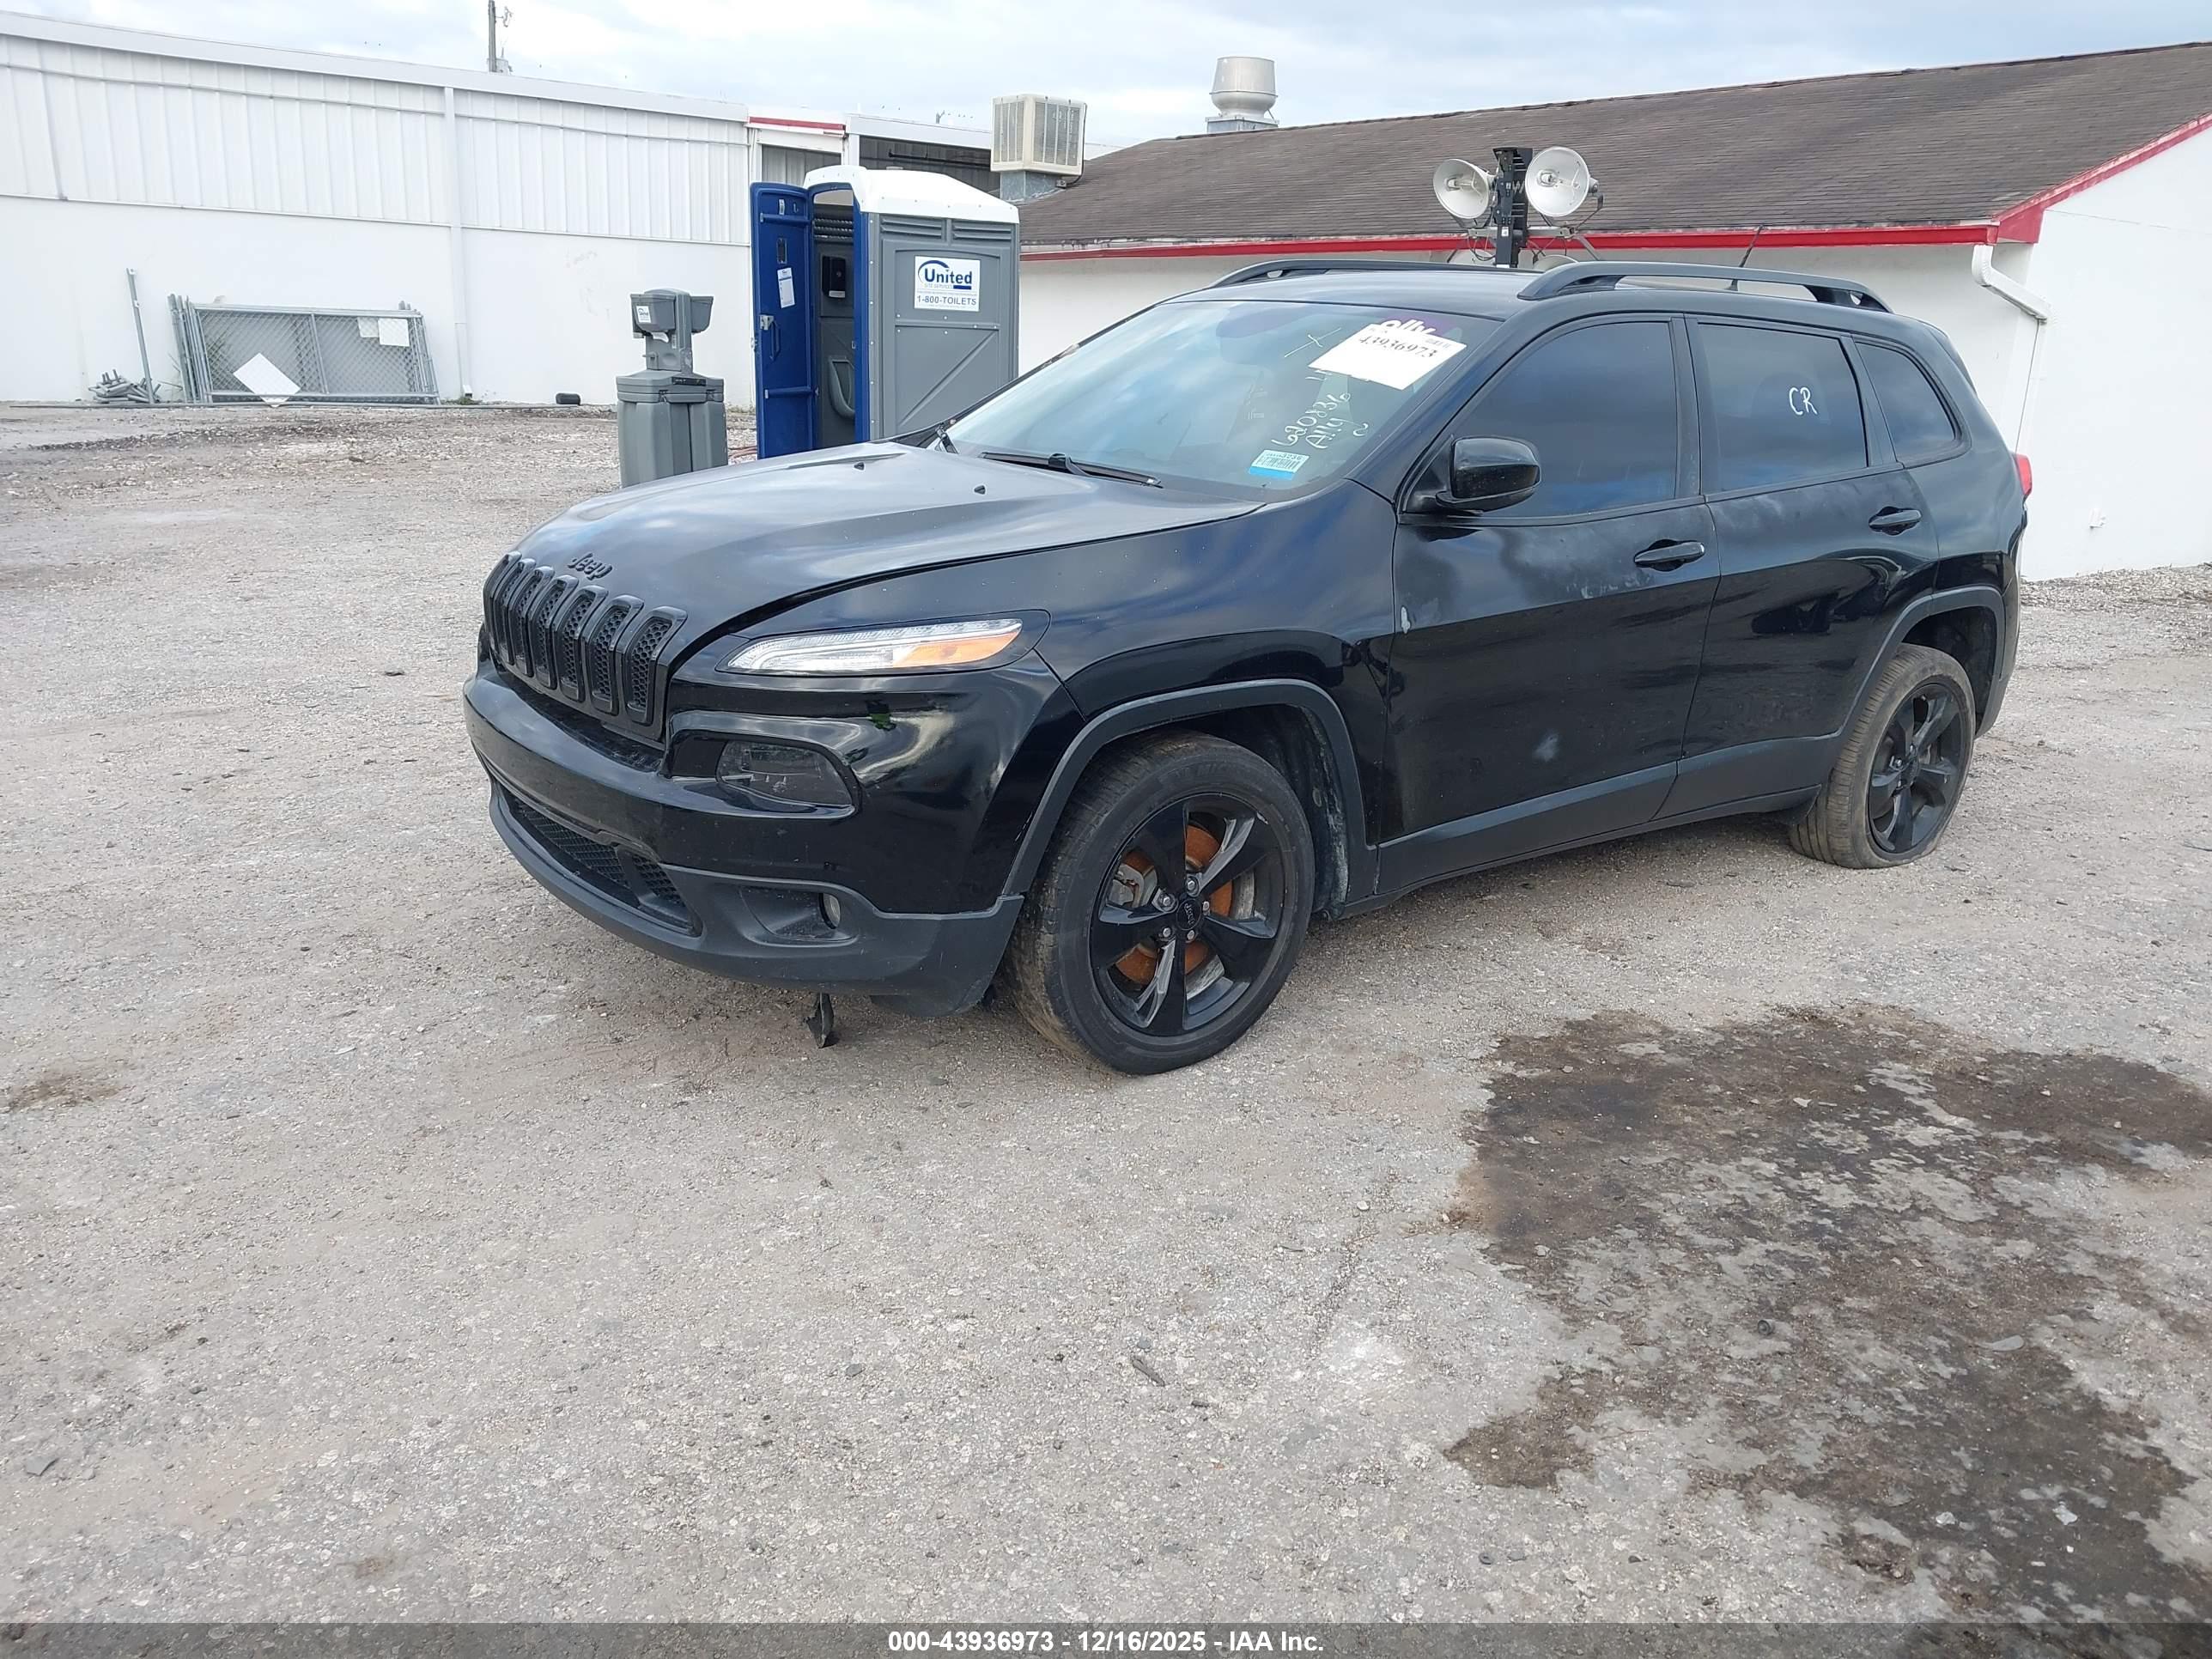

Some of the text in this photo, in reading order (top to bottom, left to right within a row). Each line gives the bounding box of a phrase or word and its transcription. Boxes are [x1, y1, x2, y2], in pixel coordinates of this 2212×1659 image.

[925, 268, 972, 284] United
[917, 295, 976, 306] 1-800-TOILETS
[1359, 335, 1437, 358] 43936973
[1789, 386, 1818, 415] CR
